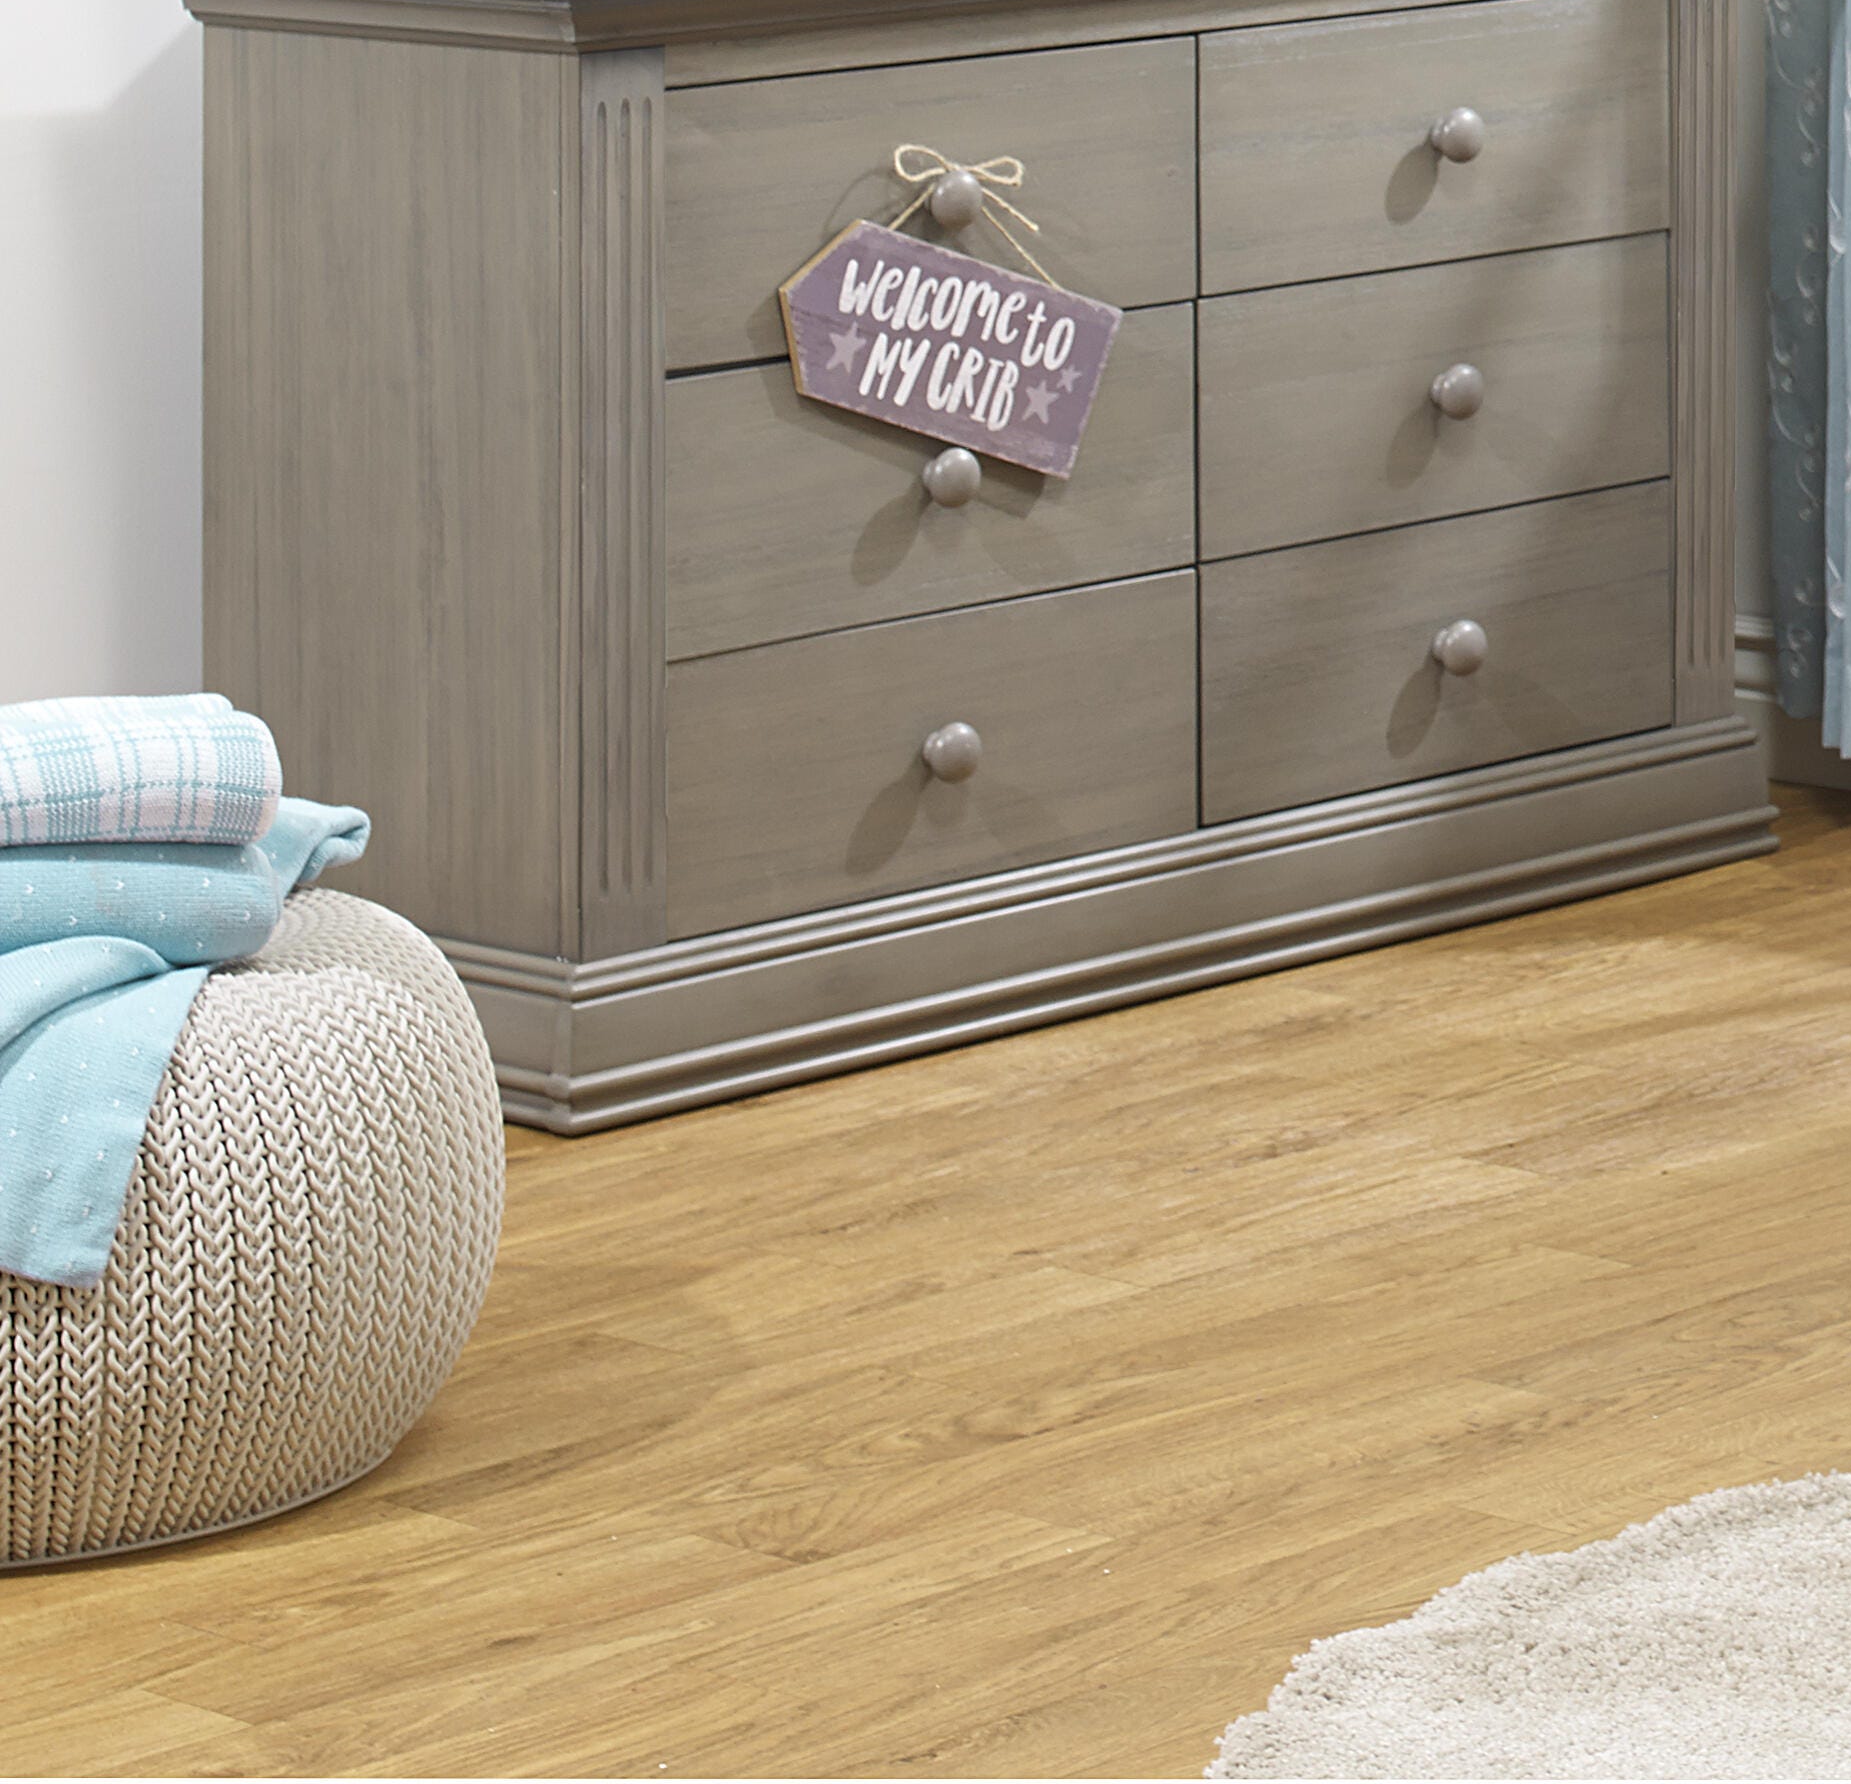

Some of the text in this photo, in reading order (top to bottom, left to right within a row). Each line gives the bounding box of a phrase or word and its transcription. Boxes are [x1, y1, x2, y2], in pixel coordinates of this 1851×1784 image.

[1020, 300, 1076, 372] to
[858, 331, 1020, 433] MY CRIB
